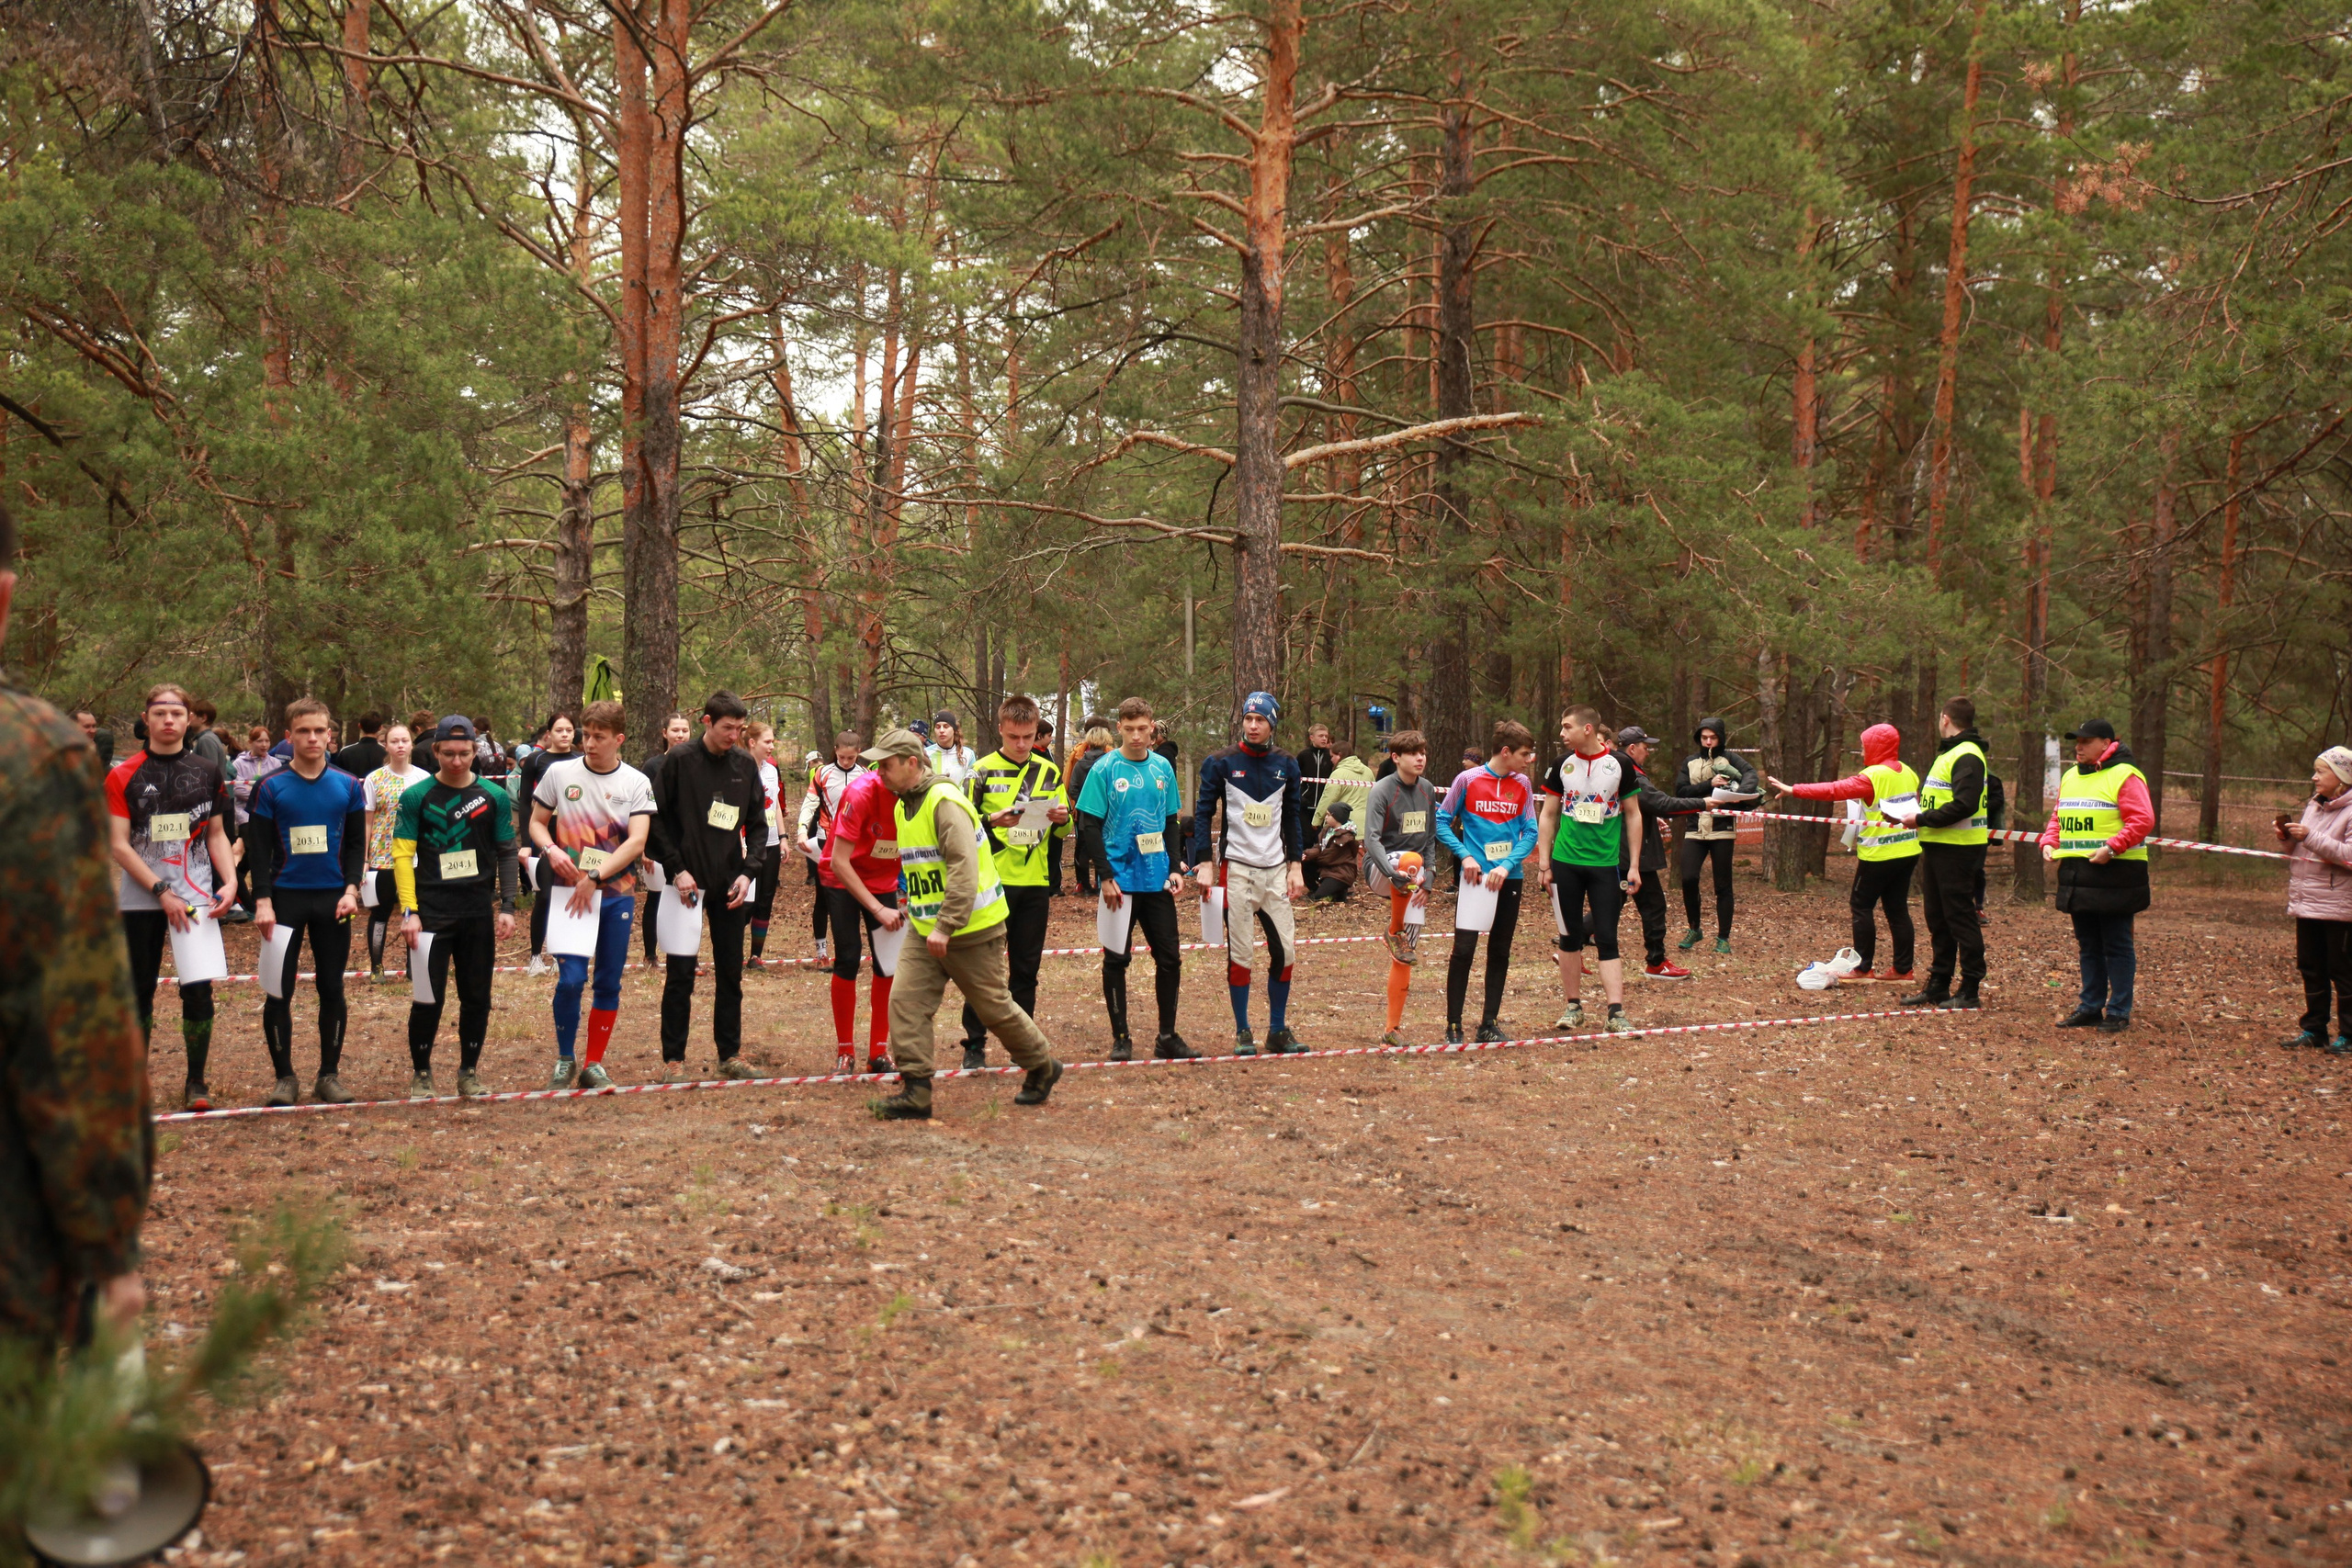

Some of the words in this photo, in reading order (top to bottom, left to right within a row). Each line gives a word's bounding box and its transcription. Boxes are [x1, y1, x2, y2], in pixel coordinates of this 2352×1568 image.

[454, 795, 486, 819] O-UGRA
[1476, 800, 1519, 814] RUSSIA
[713, 810, 733, 822] 206.1
[1248, 812, 1266, 820] 210.1
[157, 823, 183, 833] 202.1
[297, 837, 320, 846] 203.1
[878, 846, 899, 854] 207.1
[447, 859, 471, 870] 204.1
[907, 870, 945, 899] ДЬЯ
